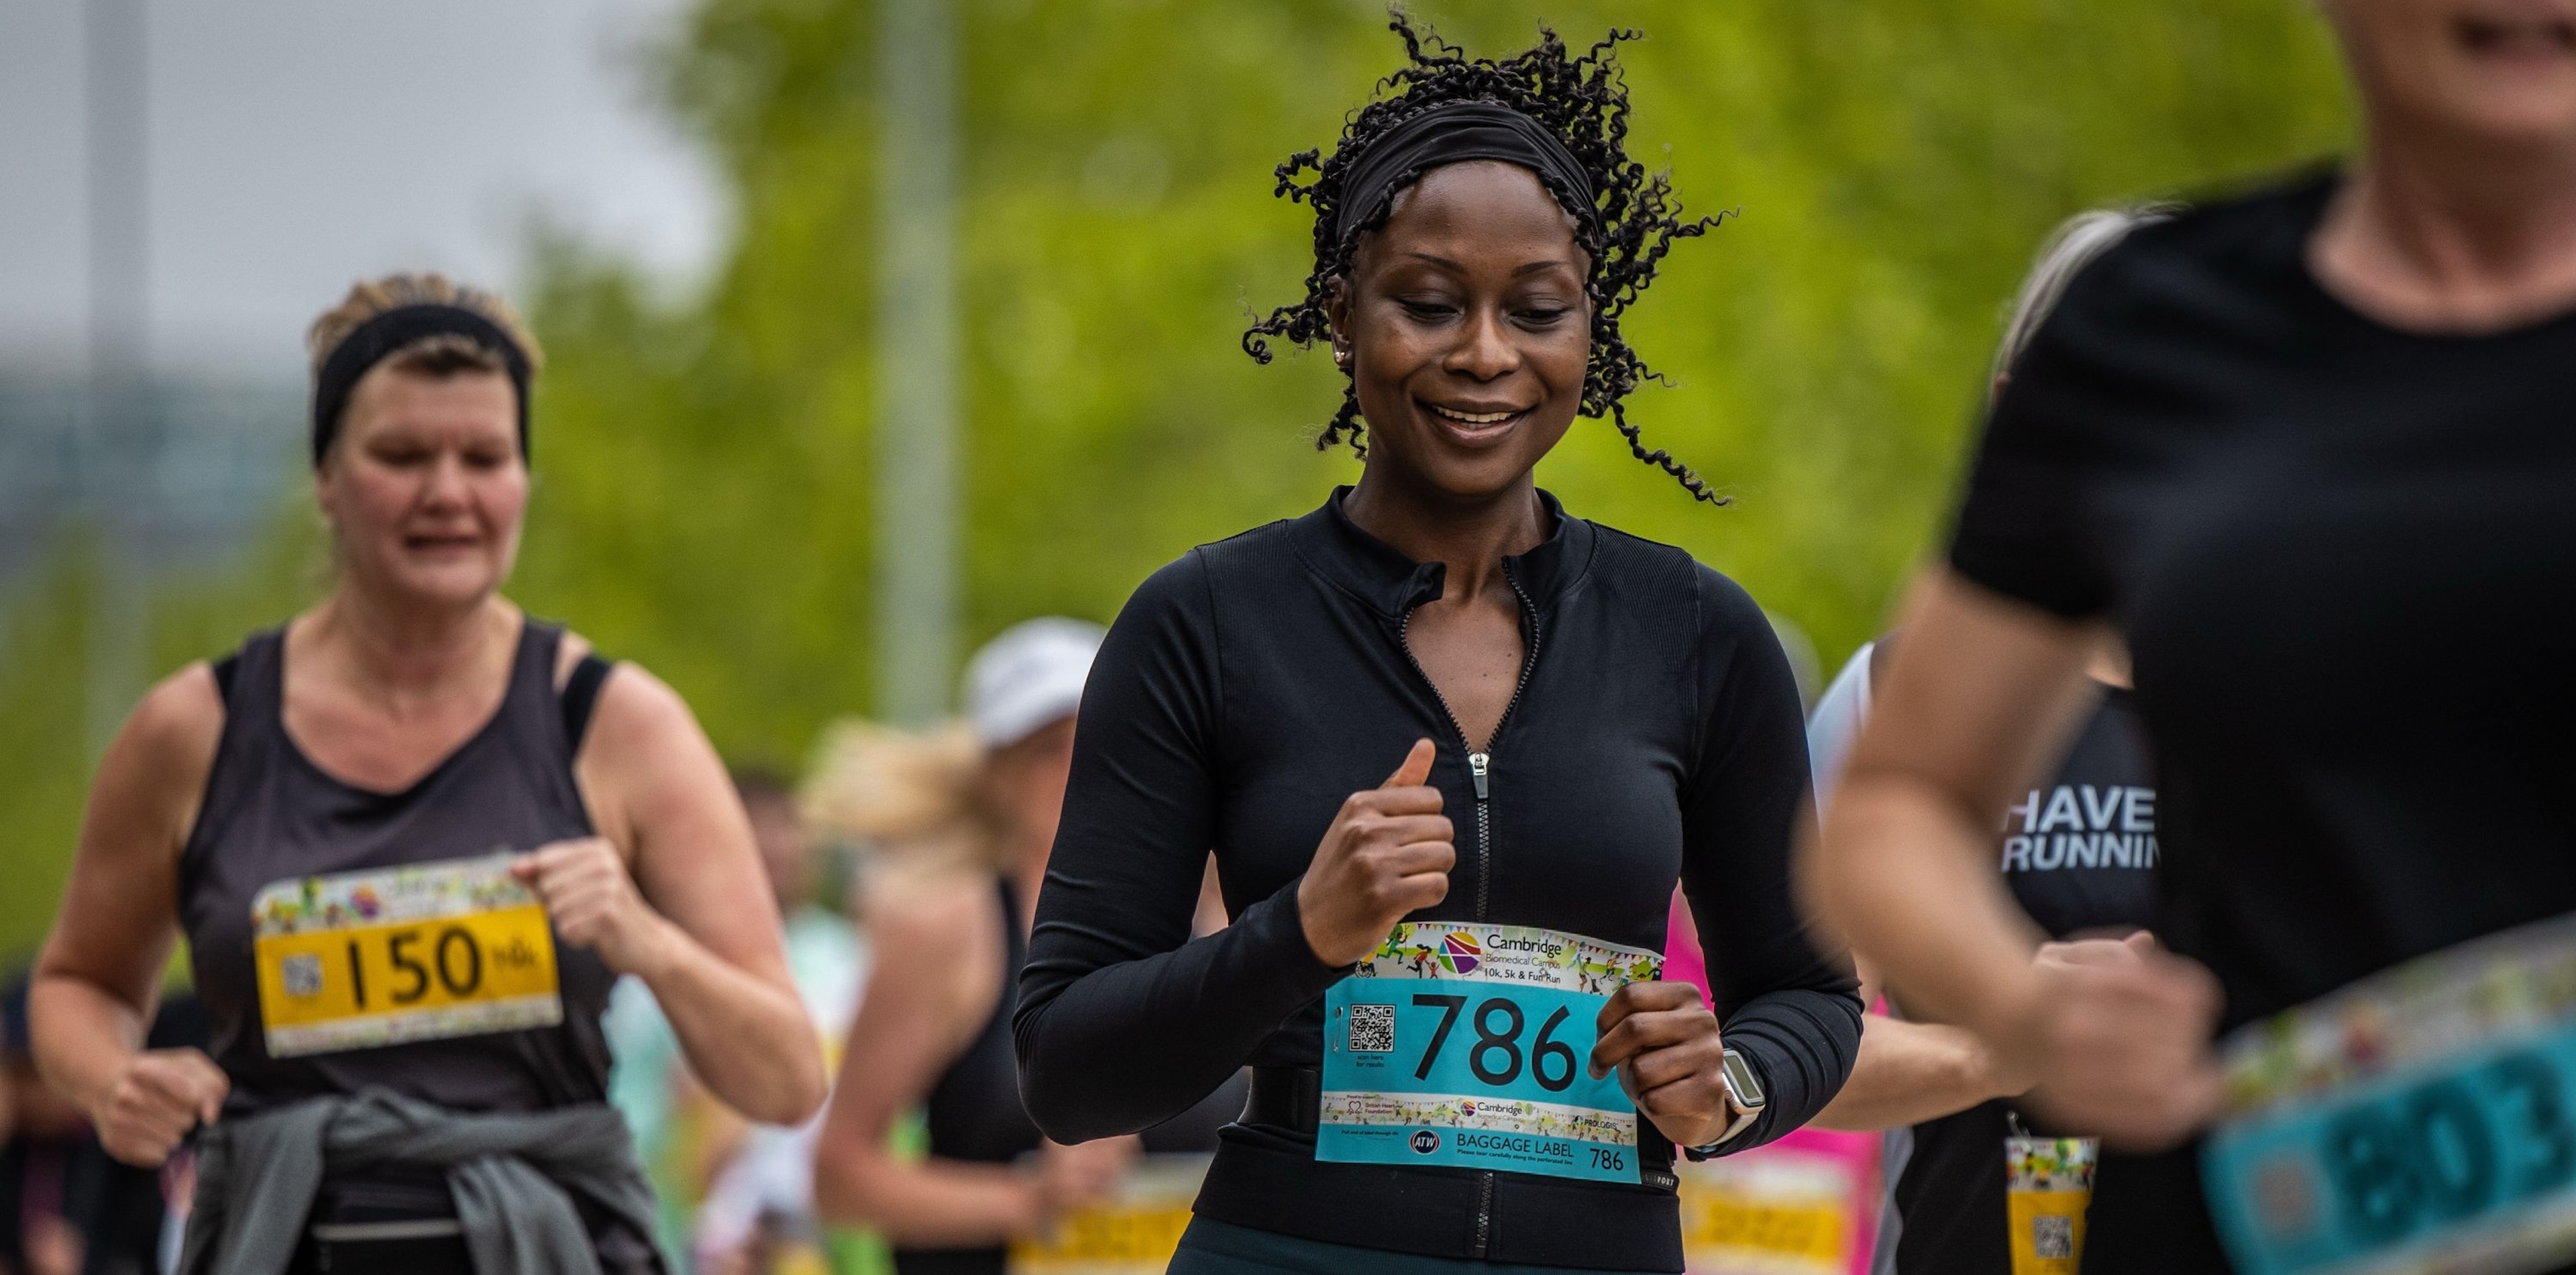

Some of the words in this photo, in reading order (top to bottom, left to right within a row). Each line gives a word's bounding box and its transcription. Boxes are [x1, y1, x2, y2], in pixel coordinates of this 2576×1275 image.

[1999, 784, 2157, 833] HAVE
[1487, 933, 1562, 958] Cambridge
[346, 925, 483, 1012] 150
[1485, 953, 1530, 965] Biomedical
[1532, 956, 1561, 969] Campus
[1485, 968, 1503, 978] 10k,
[1505, 969, 1516, 978] 5k
[1518, 970, 1525, 980] &
[1528, 971, 1543, 981] Fun
[1546, 973, 1561, 984] Run
[1411, 993, 1576, 1092] 786
[1477, 1102, 1522, 1117] Cambridge
[1585, 1118, 1617, 1129] PROLOGIS
[1415, 1136, 1436, 1148] ATW
[1457, 1133, 1531, 1153] BAGGAGE
[1535, 1141, 1574, 1158] LABEL
[2333, 1050, 2575, 1250] 803
[1513, 1154, 1527, 1162] along
[1537, 1156, 1564, 1165] perforated
[1589, 1148, 1624, 1171] 786
